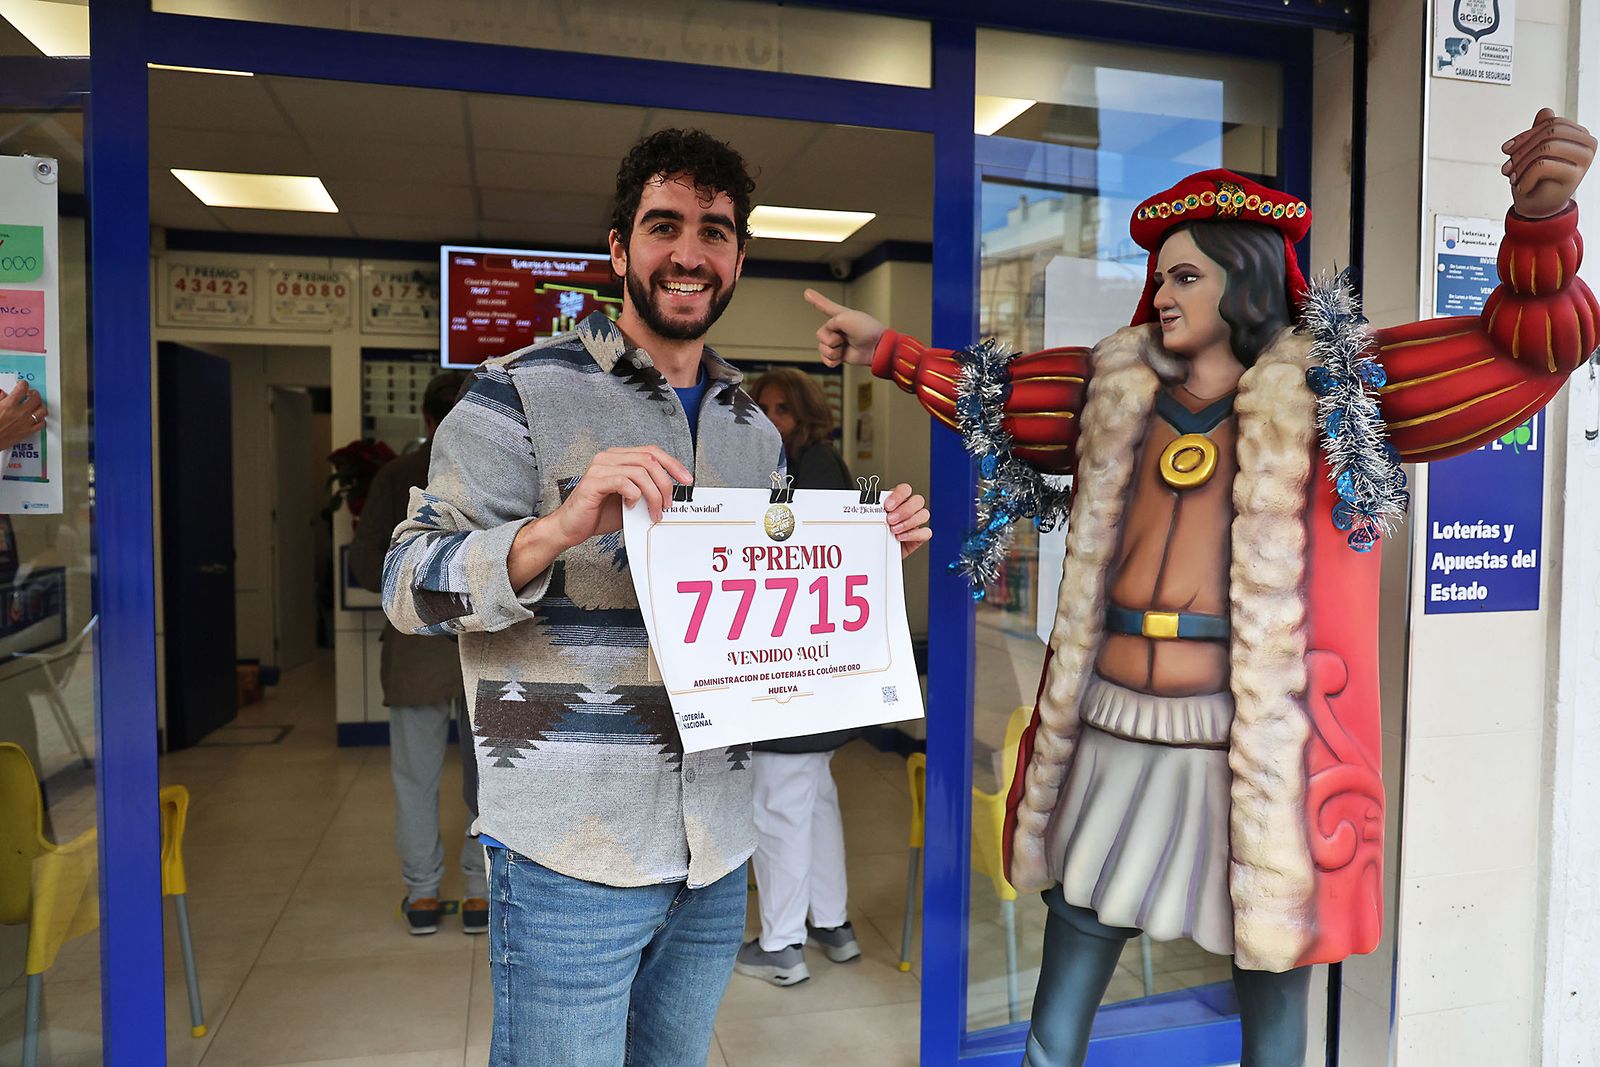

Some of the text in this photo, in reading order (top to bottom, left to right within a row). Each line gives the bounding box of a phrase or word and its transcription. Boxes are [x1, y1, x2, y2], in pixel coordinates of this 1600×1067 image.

[1460, 13, 1493, 24] acacio
[1478, 70, 1485, 79] DE
[1485, 71, 1511, 81] SEGURIDAD
[175, 278, 249, 297] 43422
[276, 282, 346, 299] 08080
[679, 505, 689, 513] de
[843, 505, 851, 513] 22
[1432, 519, 1515, 543] Loterías y
[742, 544, 842, 572] PREMIO
[1431, 549, 1536, 575] Apuestas del
[1430, 581, 1488, 602] Estado
[676, 574, 870, 644] 77715
[727, 640, 830, 666] VENDIDO AQUÍ
[693, 663, 861, 688] ADMINISTRACION DE LOTERIAS EL COLÓN DE ORO
[768, 684, 798, 695] HUELVA
[681, 710, 705, 722] LOTERÍA
[682, 719, 713, 730] NACIONAL
